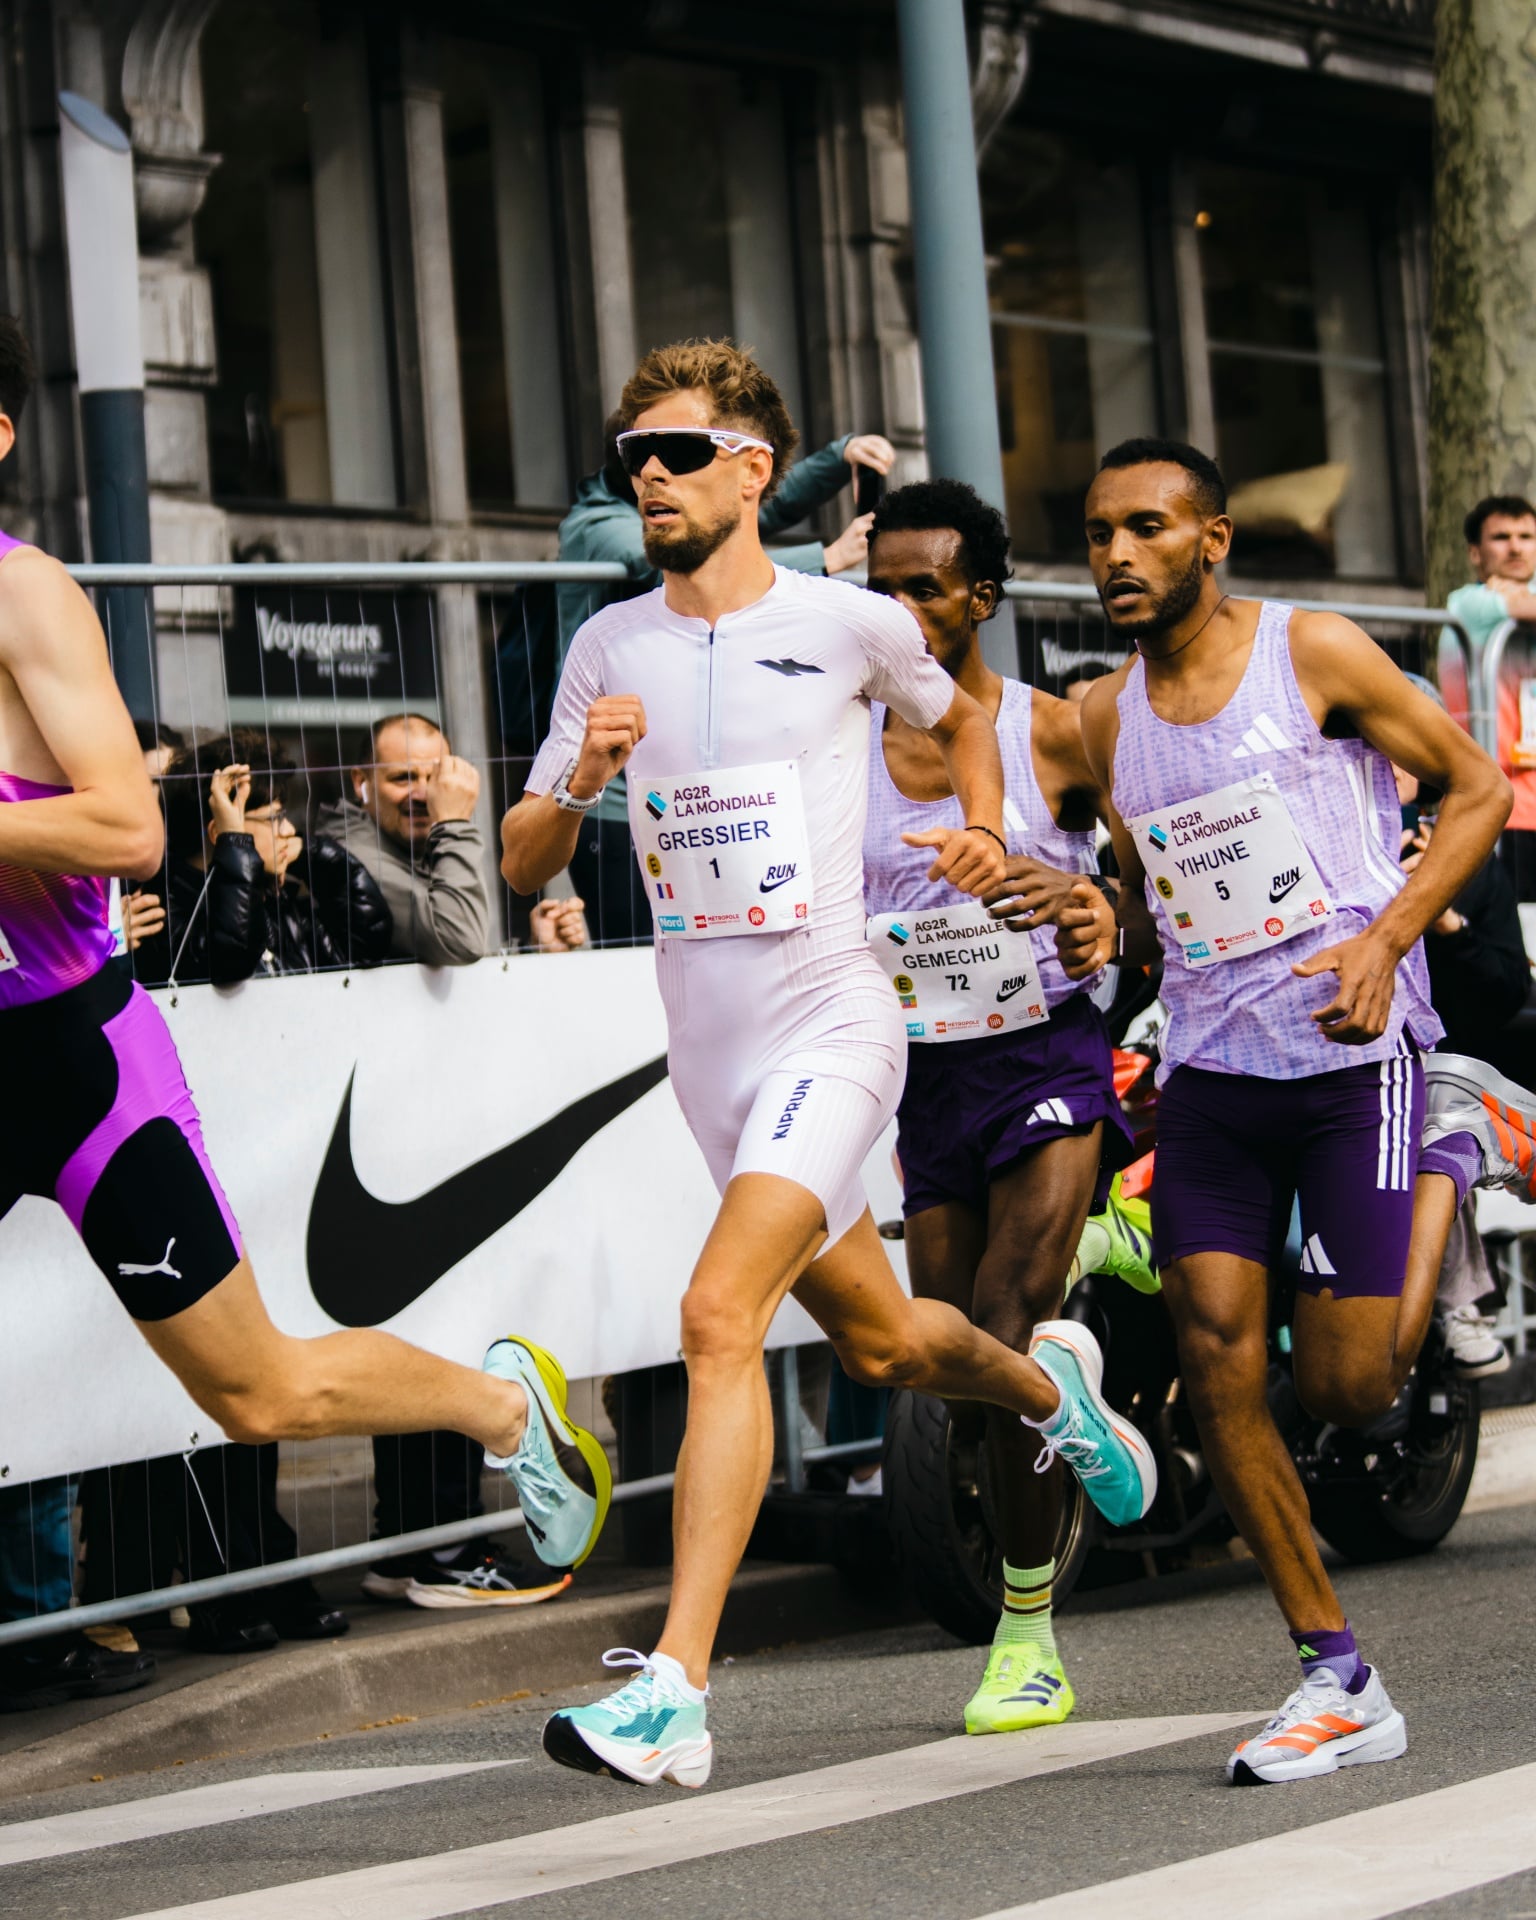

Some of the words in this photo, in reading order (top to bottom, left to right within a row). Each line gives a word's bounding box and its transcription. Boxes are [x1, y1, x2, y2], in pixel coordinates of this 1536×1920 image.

[256, 606, 381, 660] Voyageurs
[673, 785, 711, 802] AG2R
[674, 804, 695, 818] LA
[697, 792, 776, 815] MONDIALE
[1170, 811, 1204, 832] AG2R
[1173, 831, 1193, 847] LA
[1193, 806, 1262, 841] MONDIALE
[657, 820, 771, 851] GRESSIER
[709, 857, 721, 879] 1
[1174, 840, 1250, 878] YIHUNE
[766, 863, 797, 881] RUN
[1272, 866, 1300, 891] RUN
[1158, 879, 1171, 897] E
[1214, 879, 1231, 901] 5
[659, 916, 683, 928] Nord
[914, 918, 949, 933] AG2R
[916, 931, 934, 945] LA
[936, 920, 1004, 942] MONDIALE
[902, 943, 1000, 969] GEMECHU
[898, 977, 909, 991] E
[945, 973, 971, 991] 72
[1001, 974, 1027, 992] RUN
[906, 1023, 922, 1033] ord
[771, 1078, 814, 1141] KIPRUN
